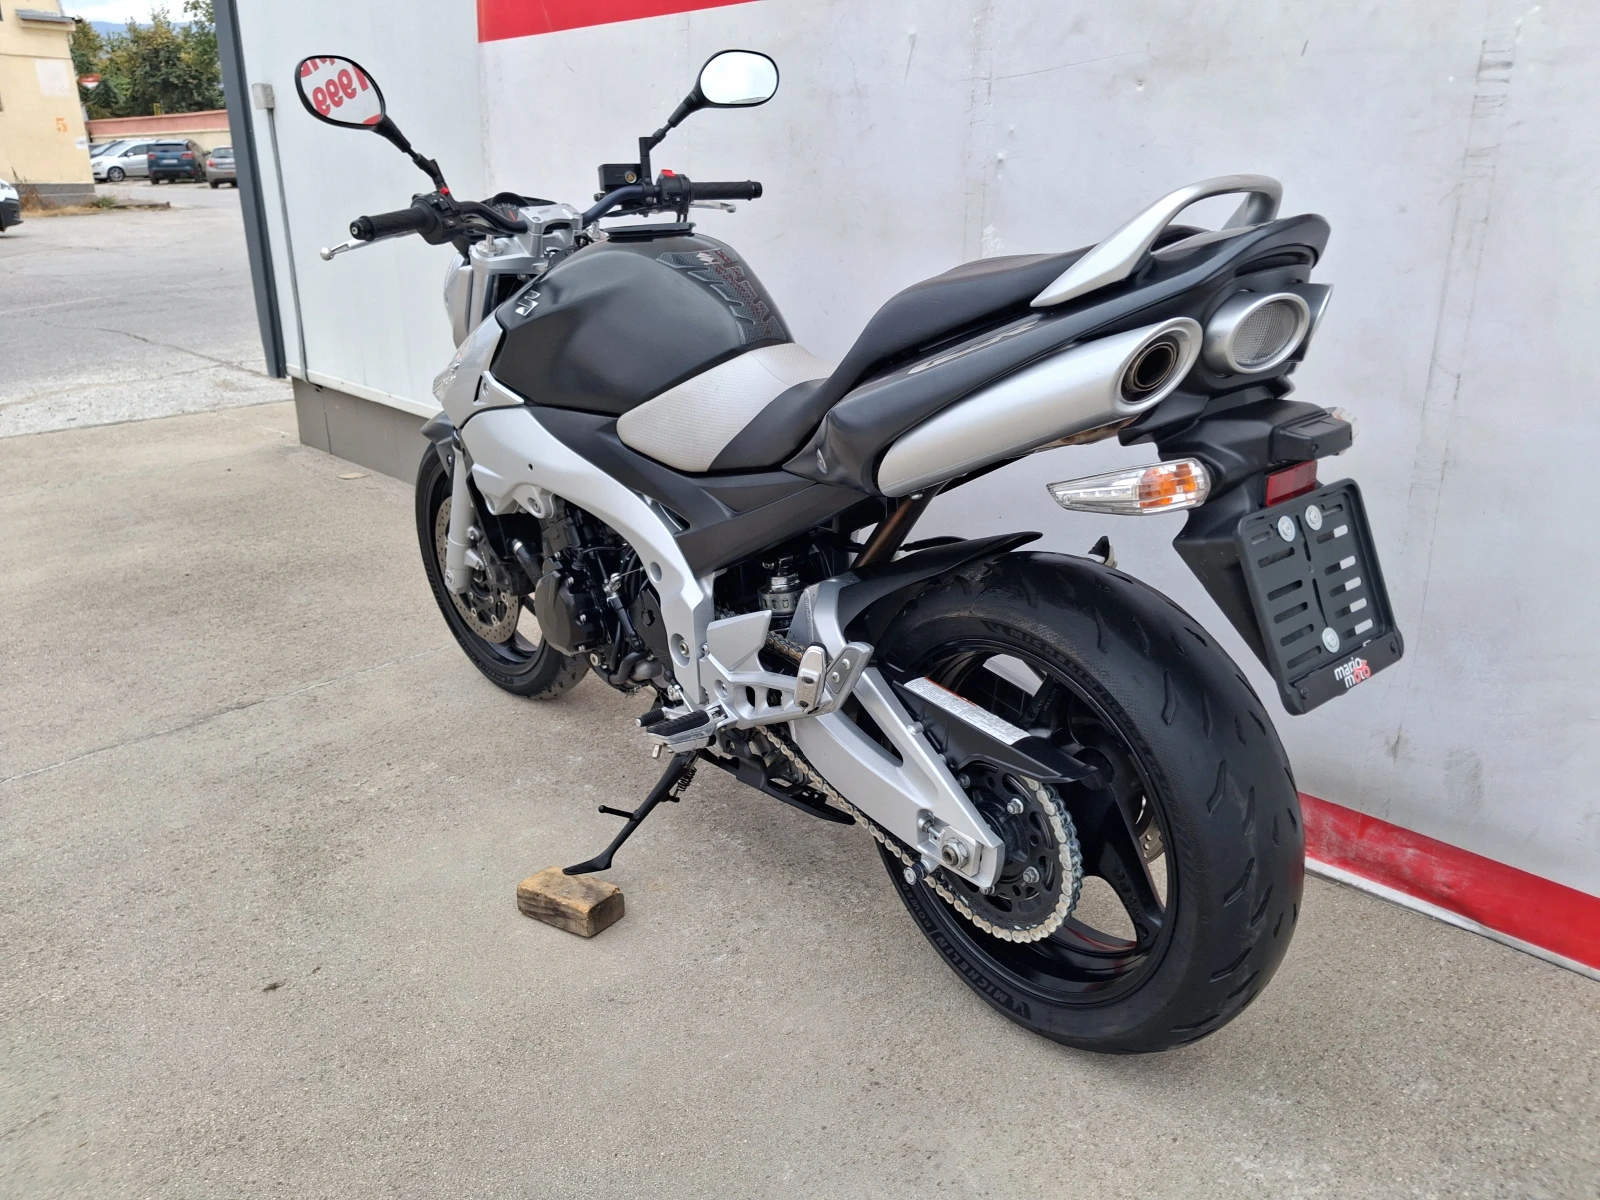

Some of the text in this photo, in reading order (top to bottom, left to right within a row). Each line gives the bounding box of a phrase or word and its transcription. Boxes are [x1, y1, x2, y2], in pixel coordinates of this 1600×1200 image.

[56, 117, 68, 132] 5
[1010, 629, 1098, 689] MICHELIN
[1334, 657, 1363, 681] mario
[1344, 666, 1370, 688] moto
[901, 883, 1008, 1002] MICHELIN POWER
